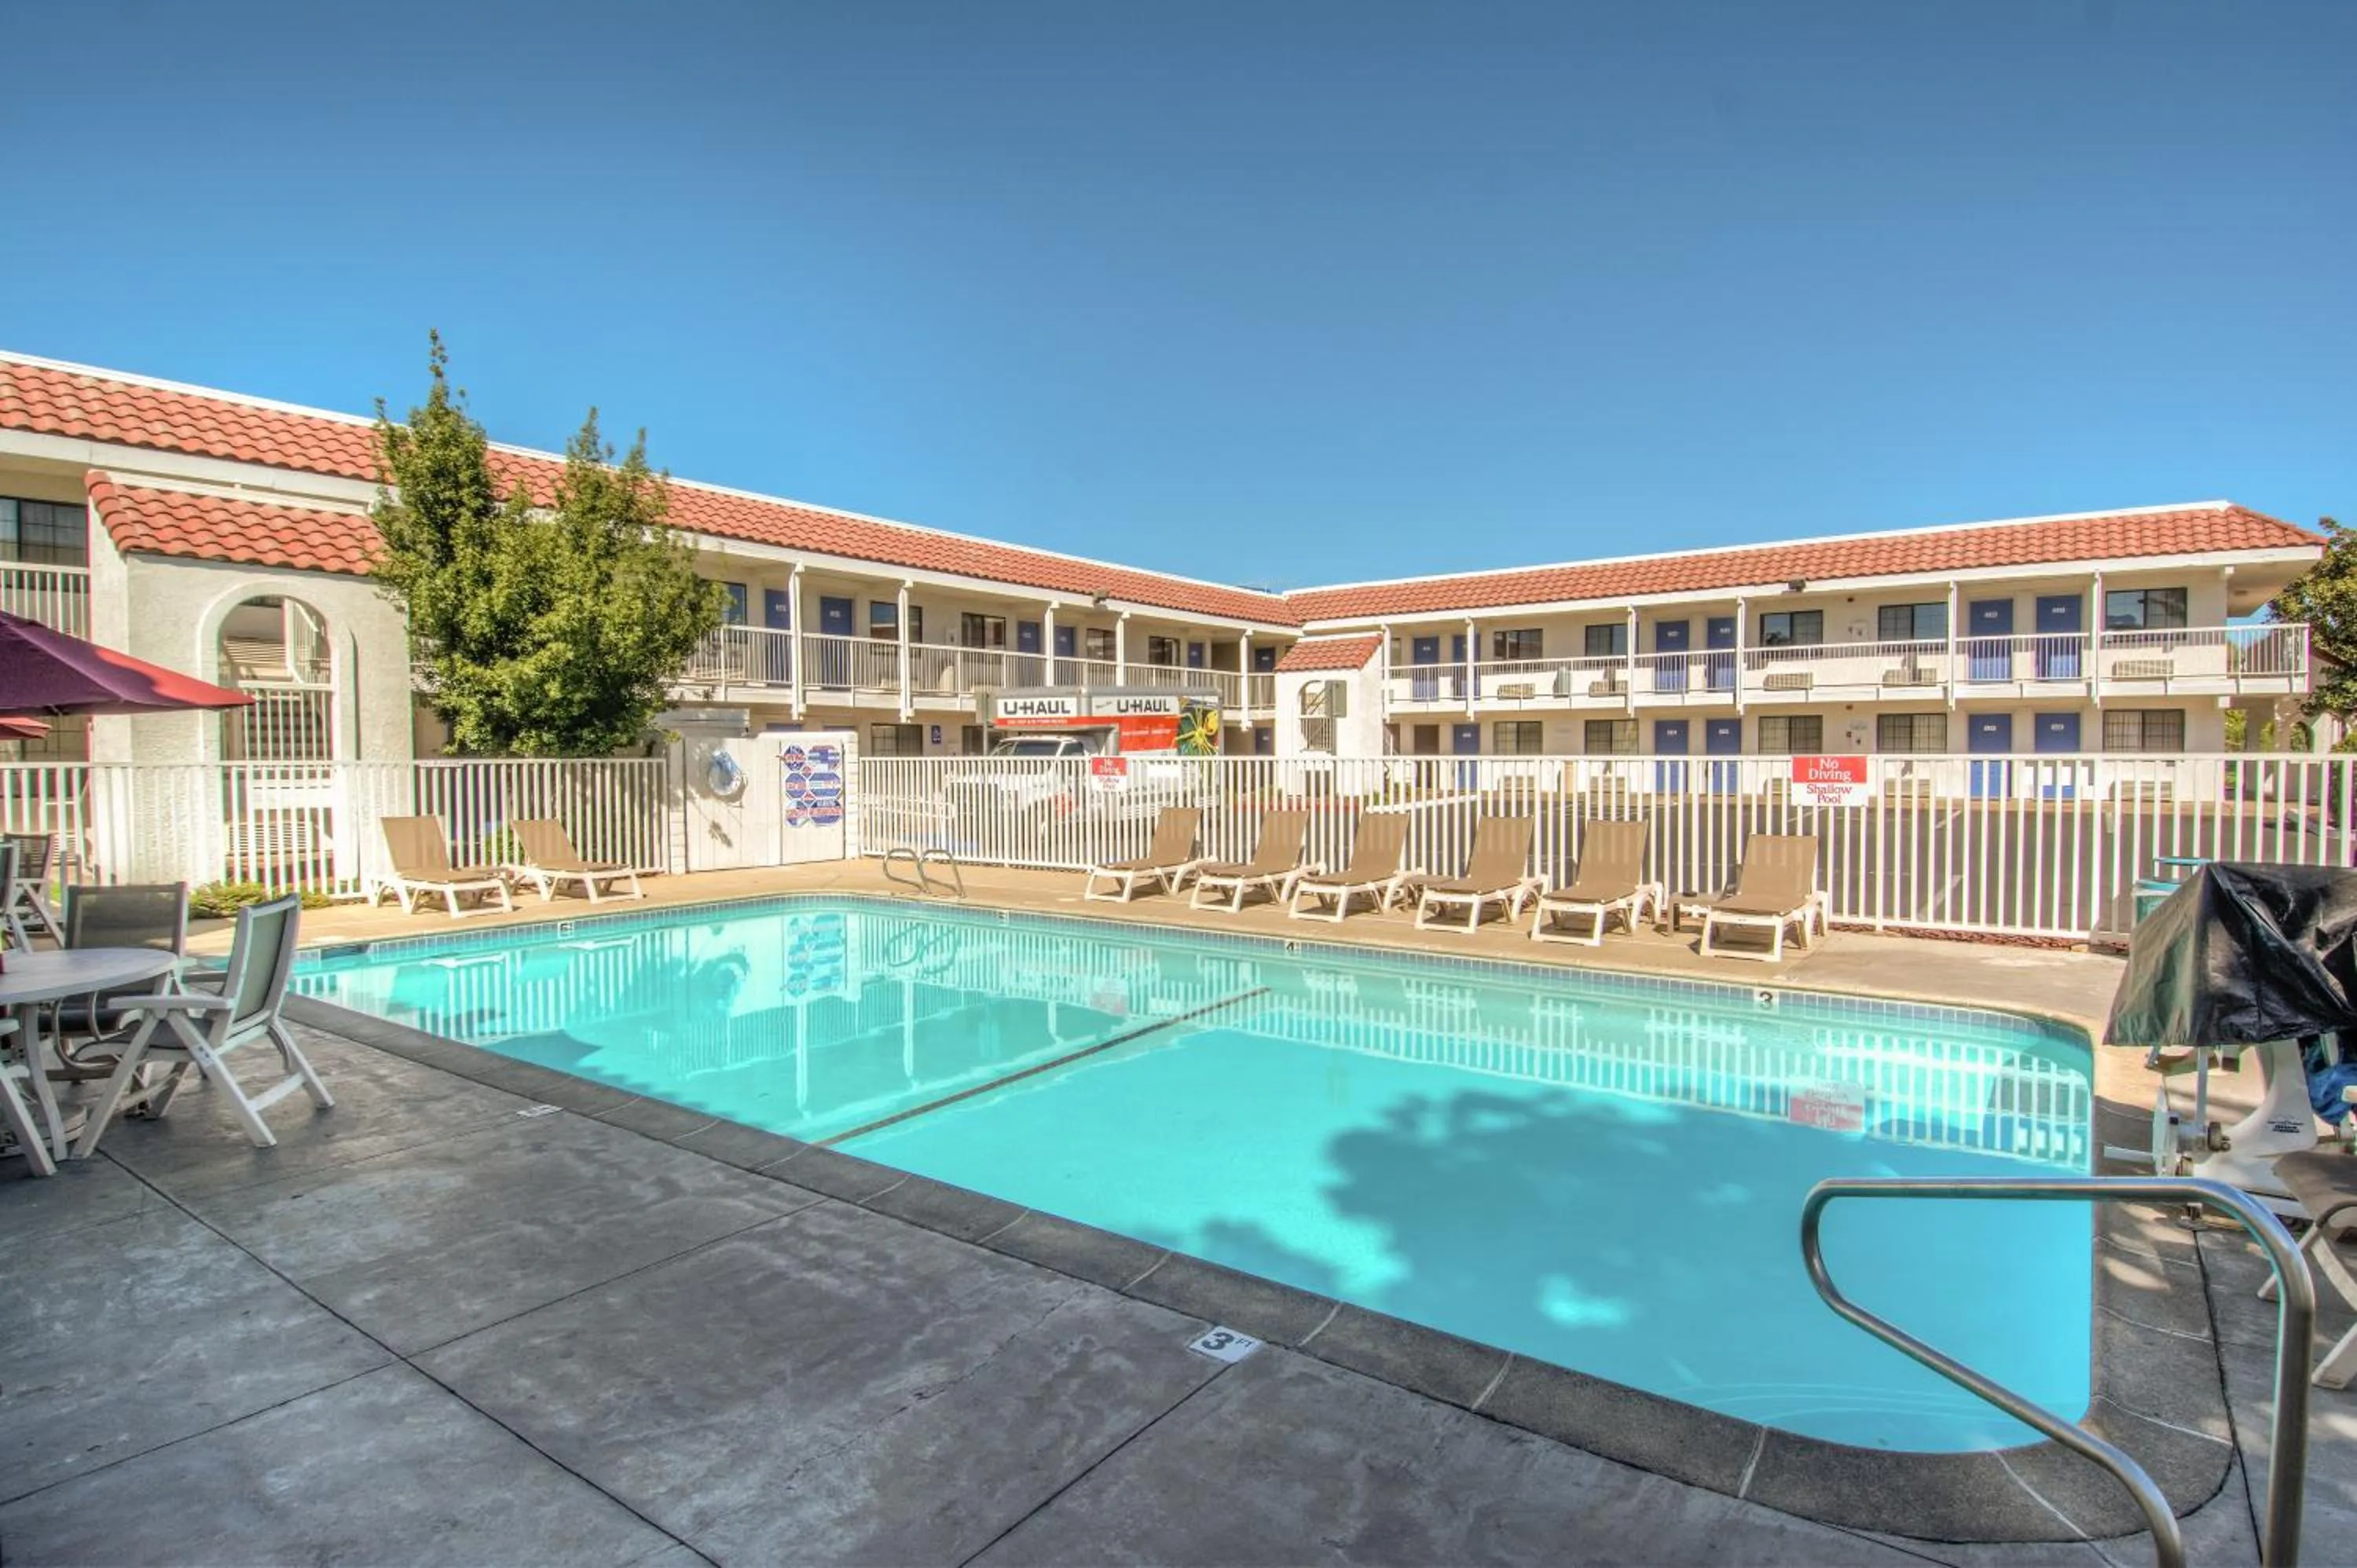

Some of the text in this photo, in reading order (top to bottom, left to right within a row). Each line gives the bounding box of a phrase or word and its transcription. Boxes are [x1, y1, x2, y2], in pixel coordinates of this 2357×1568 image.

[1004, 700, 1071, 715] U-HAUL
[1117, 698, 1170, 713] U-HAUL
[1820, 758, 1838, 769] No
[1809, 768, 1852, 782] Diving
[1806, 783, 1853, 794] Shallow
[1817, 794, 1842, 804] Pool
[1201, 1332, 1234, 1350] 3
